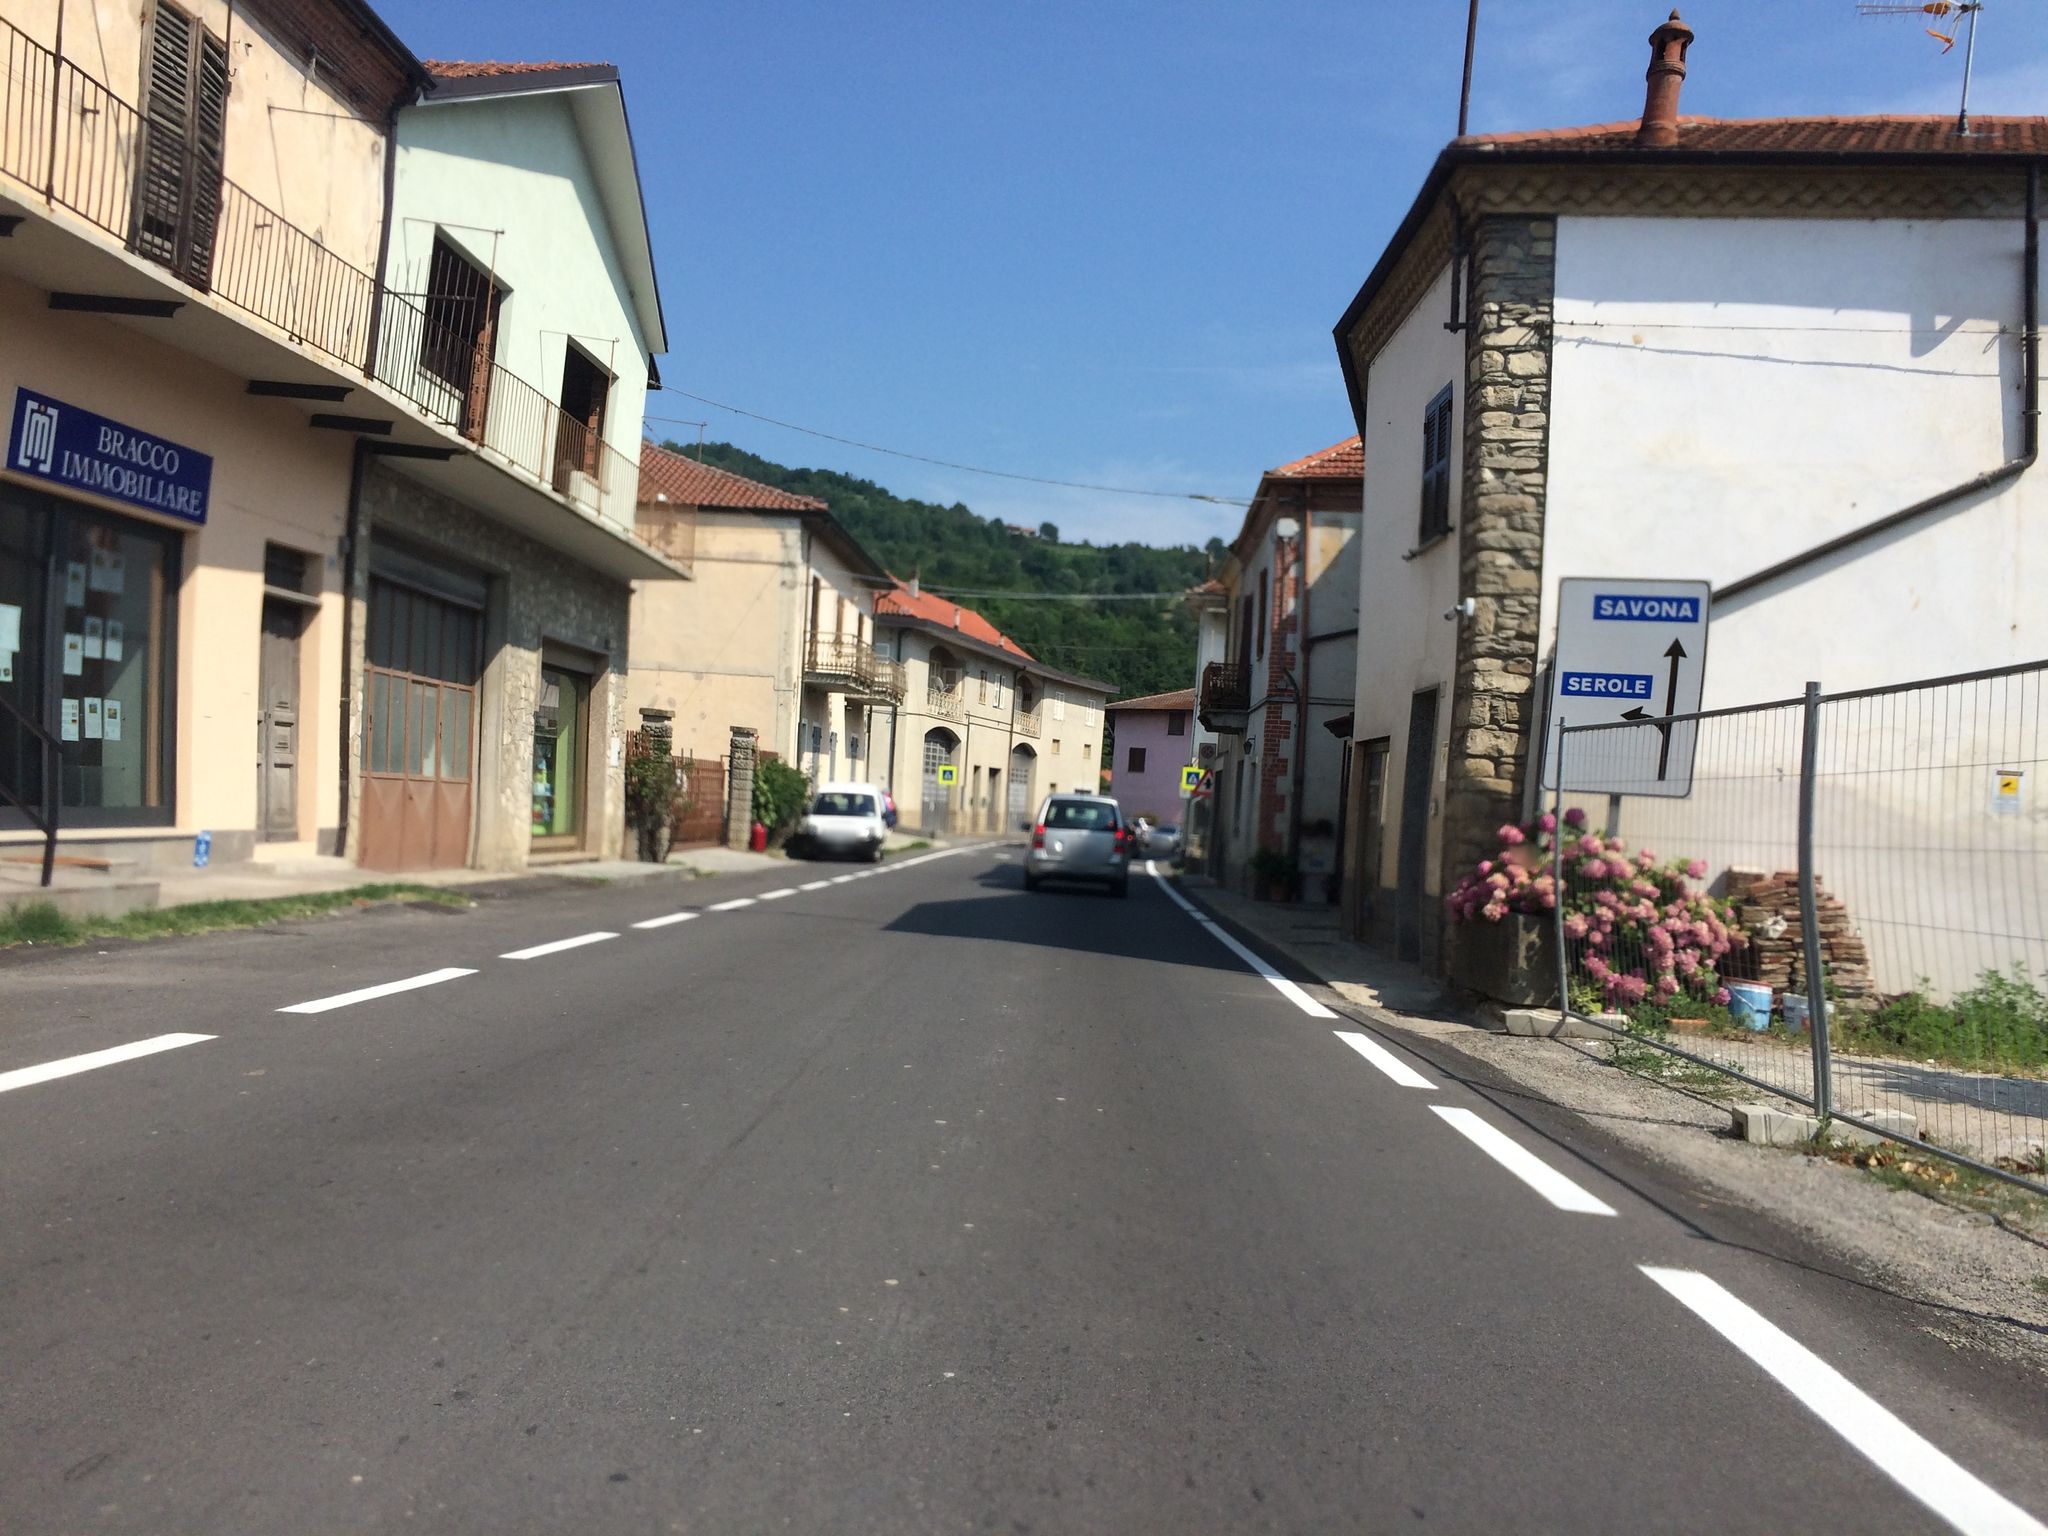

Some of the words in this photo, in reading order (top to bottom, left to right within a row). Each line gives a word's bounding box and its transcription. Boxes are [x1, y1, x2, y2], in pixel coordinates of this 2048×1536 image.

[97, 425, 180, 476] BRACCO
[61, 450, 202, 516] IMMOBILIARE
[1600, 599, 1693, 618] SAVONA
[1567, 677, 1647, 694] SEROLE
